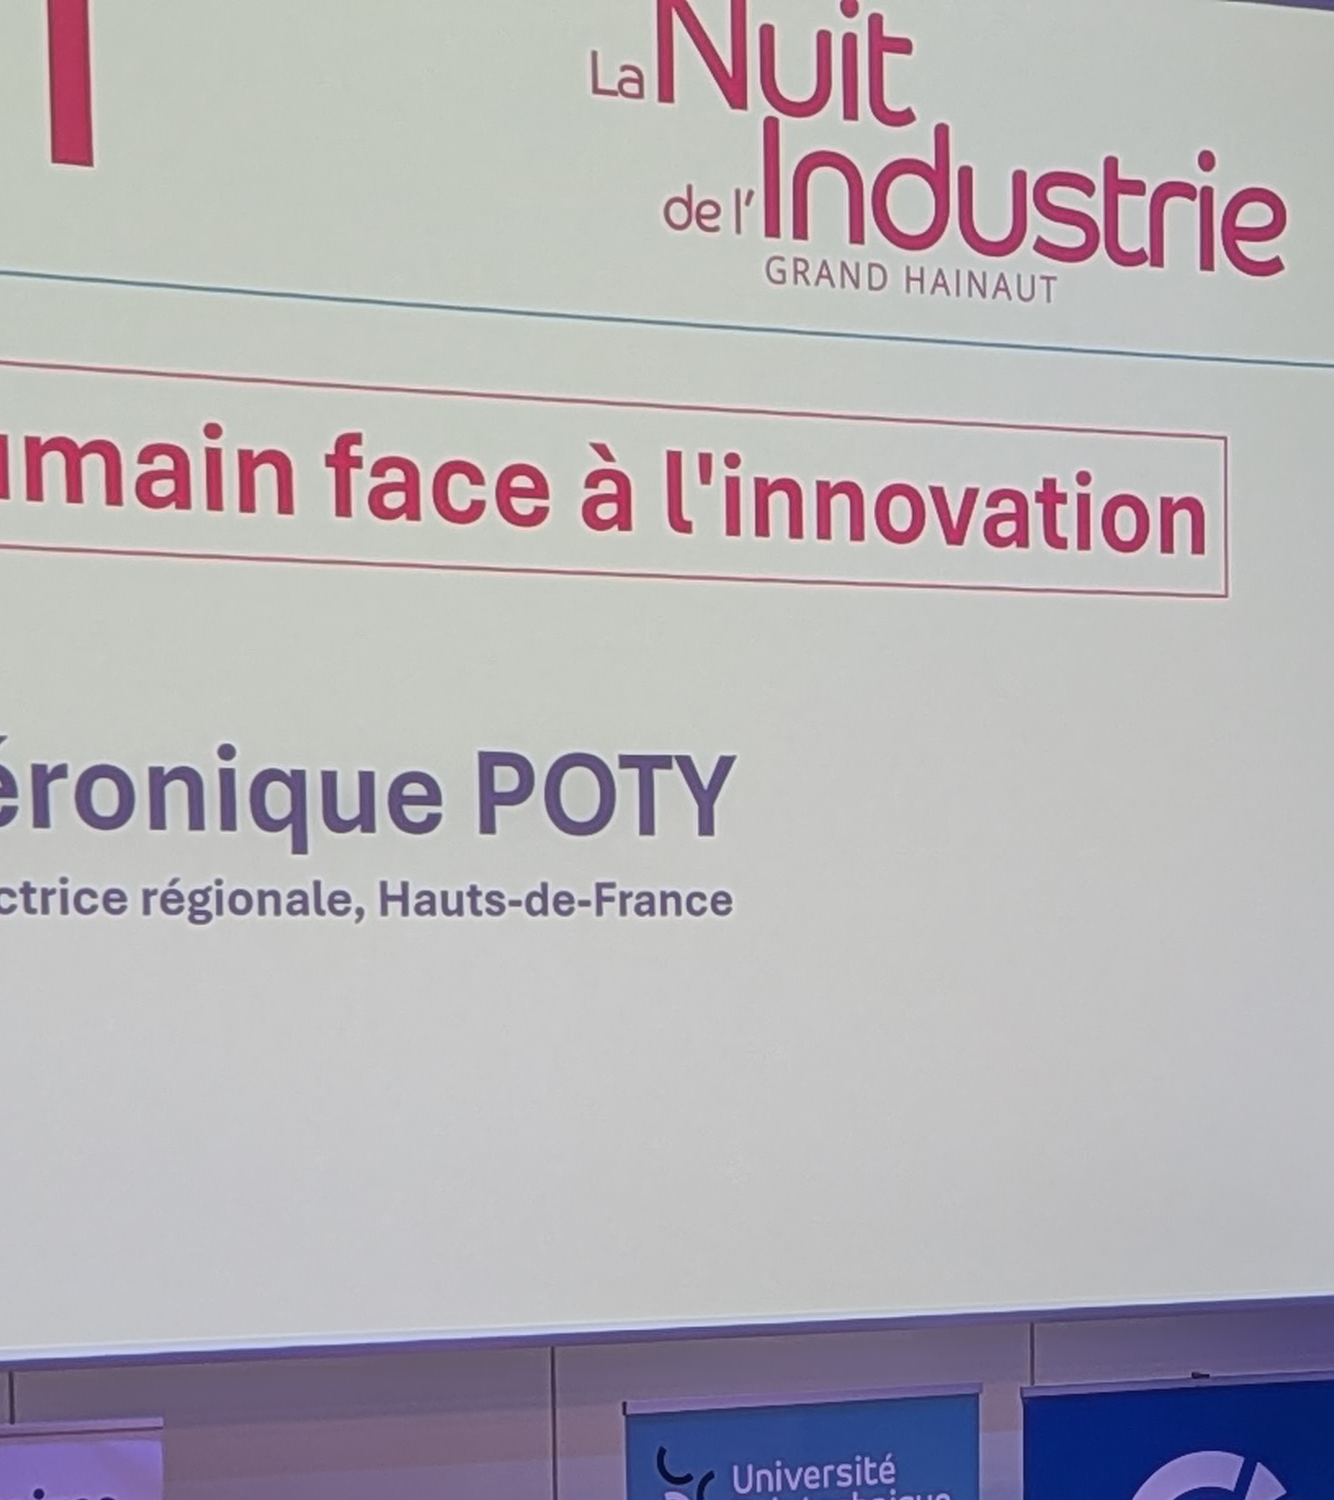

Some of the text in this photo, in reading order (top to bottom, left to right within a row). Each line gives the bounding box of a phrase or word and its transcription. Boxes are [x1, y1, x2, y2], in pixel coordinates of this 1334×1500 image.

[588, 0, 917, 127] La Nuit
[662, 183, 723, 234] de
[762, 113, 1289, 278] Industrie
[763, 253, 1059, 306] GRAND HAINAUT
[323, 430, 554, 530] face
[579, 441, 636, 534] à
[665, 449, 1208, 557] l'innovation
[475, 749, 739, 839] POTY
[139, 877, 367, 927] régionale,
[378, 879, 735, 919] Hauts-de-France
[731, 1453, 898, 1495] Université
